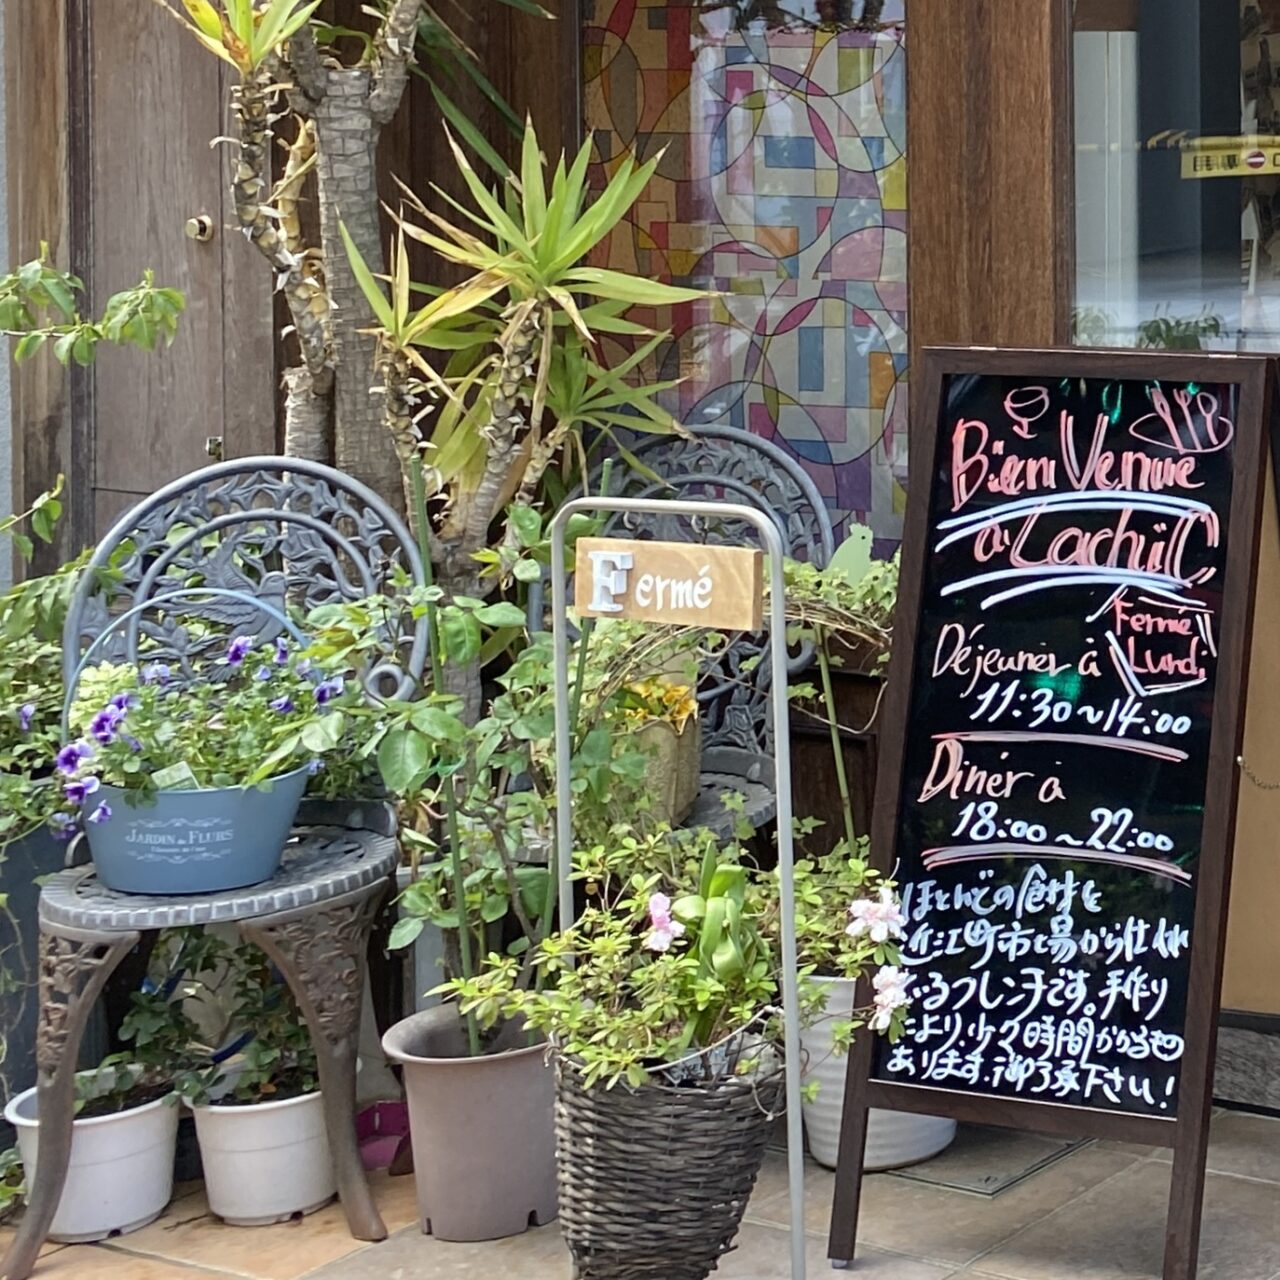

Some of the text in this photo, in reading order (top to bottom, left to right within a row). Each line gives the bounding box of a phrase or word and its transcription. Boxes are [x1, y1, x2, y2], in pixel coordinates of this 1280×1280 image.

[951, 418, 1056, 513] Bien
[587, 549, 713, 613] Fermé
[125, 828, 177, 845] JARDIN
